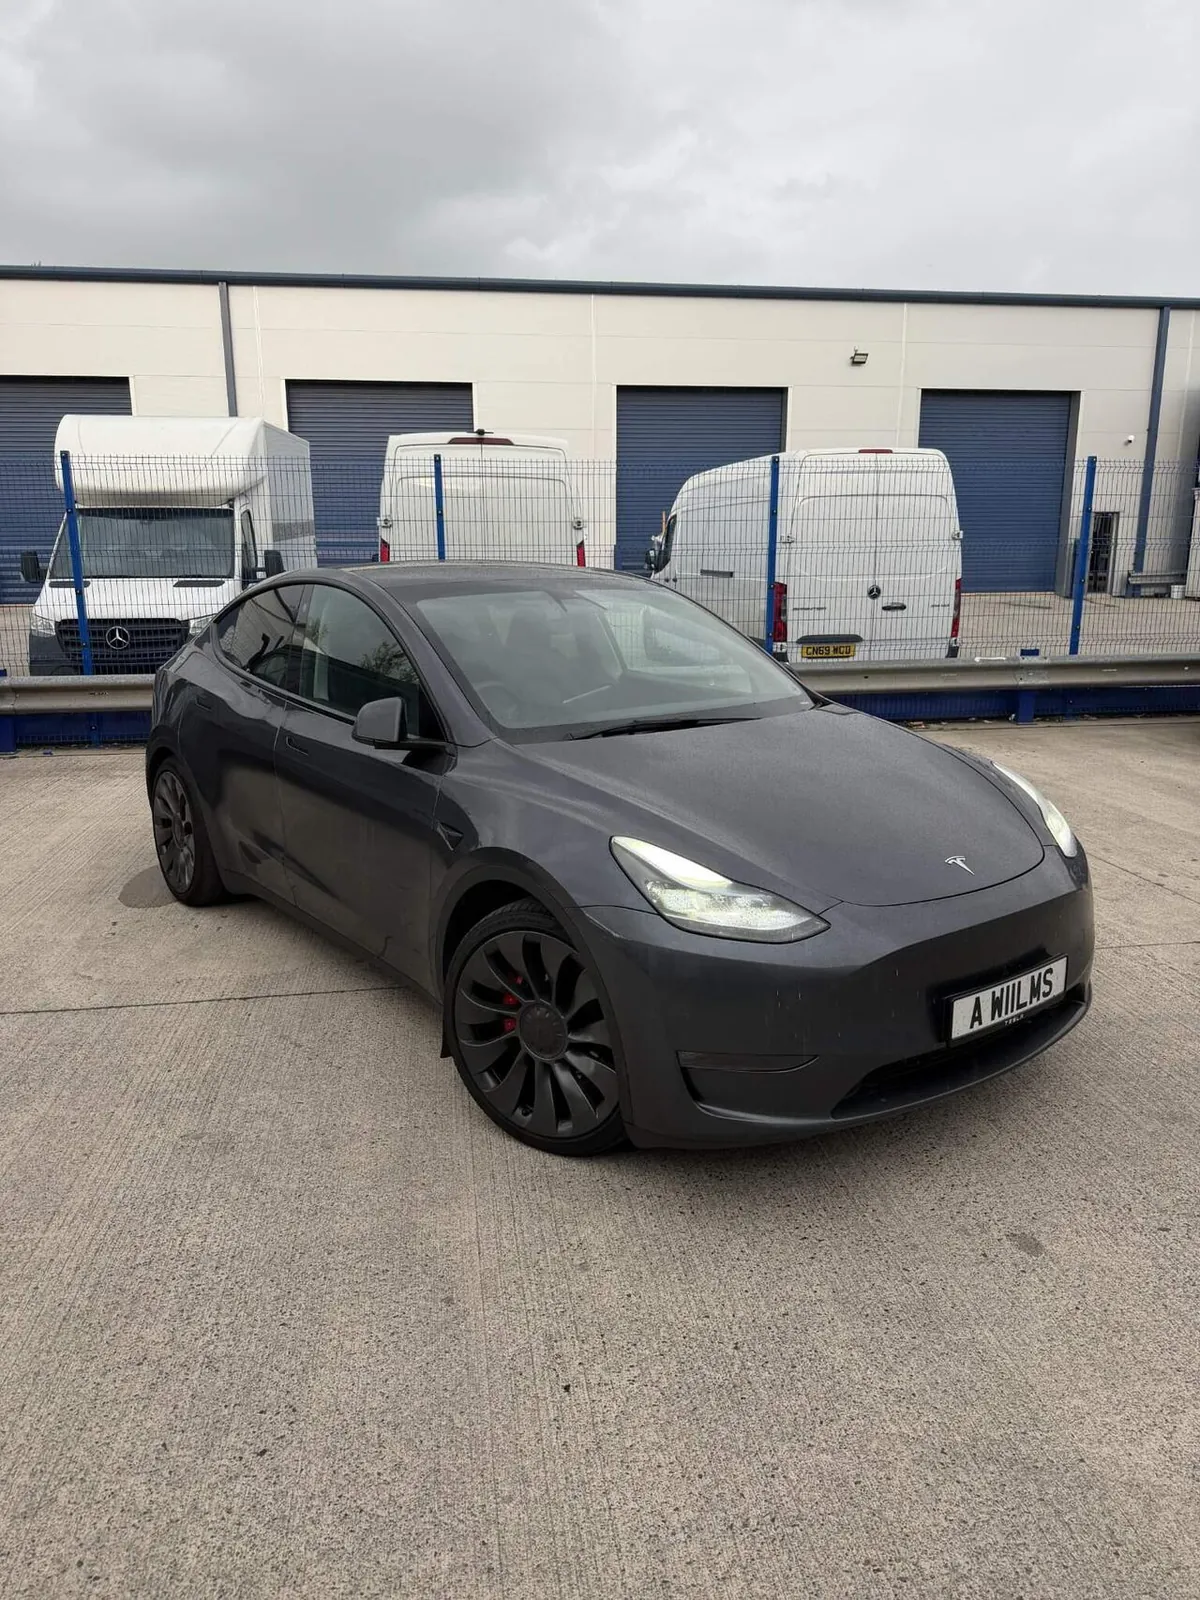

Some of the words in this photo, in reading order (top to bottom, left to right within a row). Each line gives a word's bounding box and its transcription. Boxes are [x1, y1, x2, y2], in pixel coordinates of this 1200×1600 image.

[806, 646, 830, 655] CN69
[969, 996, 983, 1029] A
[990, 967, 1054, 1021] WIILMS
